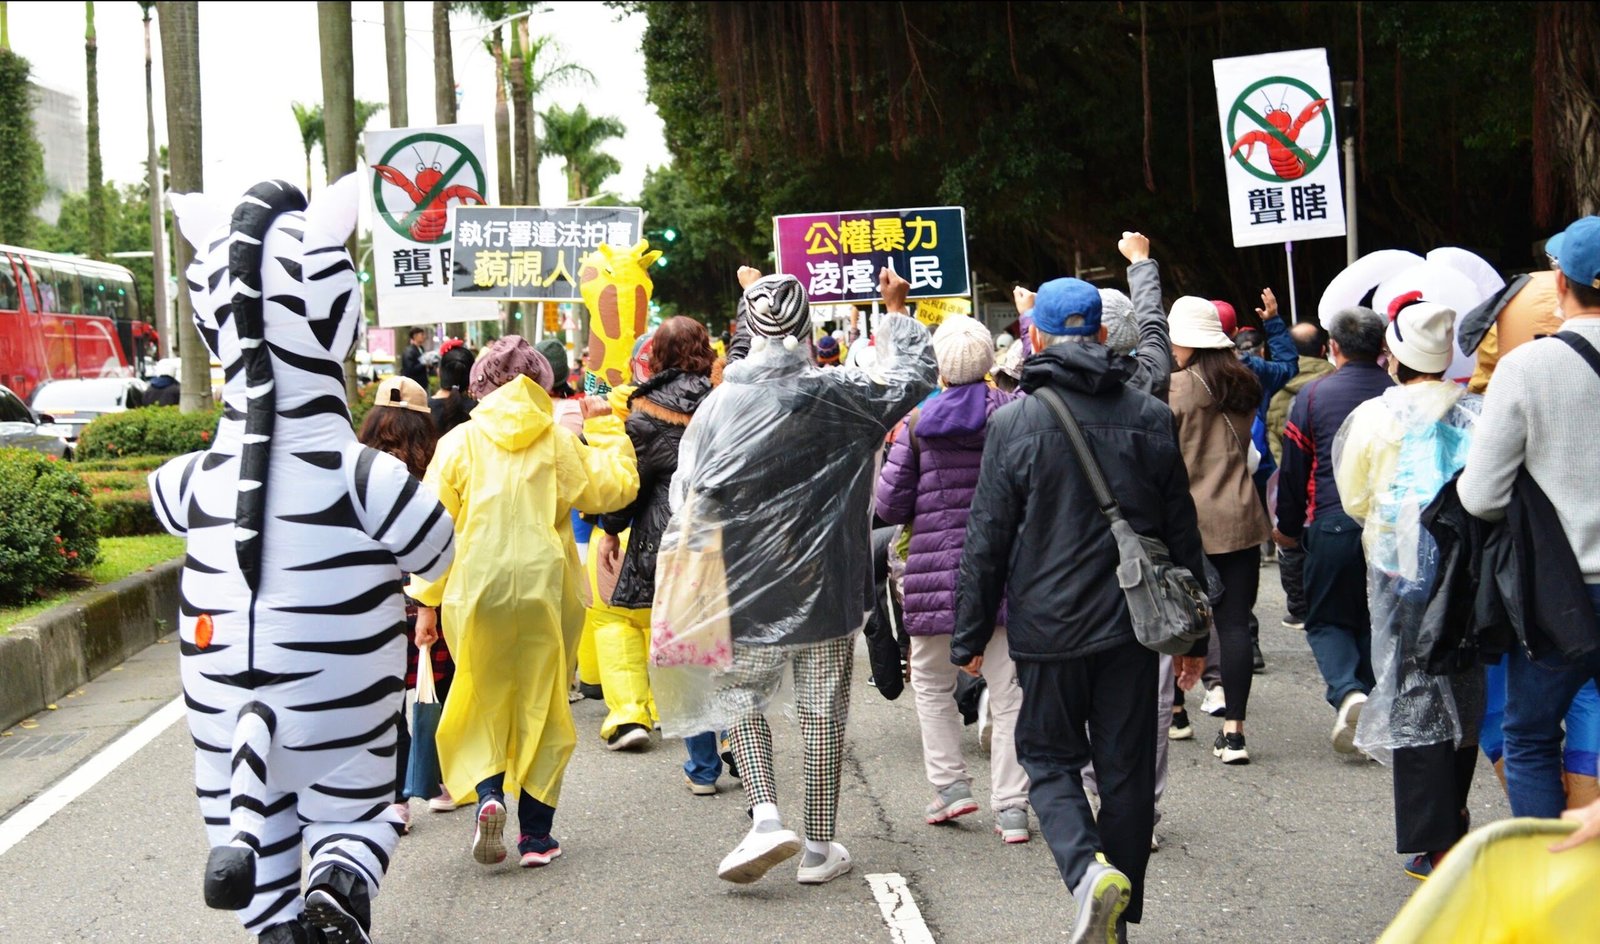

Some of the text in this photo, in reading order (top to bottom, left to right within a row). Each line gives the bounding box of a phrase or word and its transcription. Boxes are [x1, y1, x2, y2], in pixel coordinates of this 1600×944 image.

[1248, 183, 1327, 225] 聾瞎
[458, 220, 632, 248] 執行署違法拍賣
[804, 216, 938, 255] 公權暴力
[473, 250, 595, 288] 藐視人
